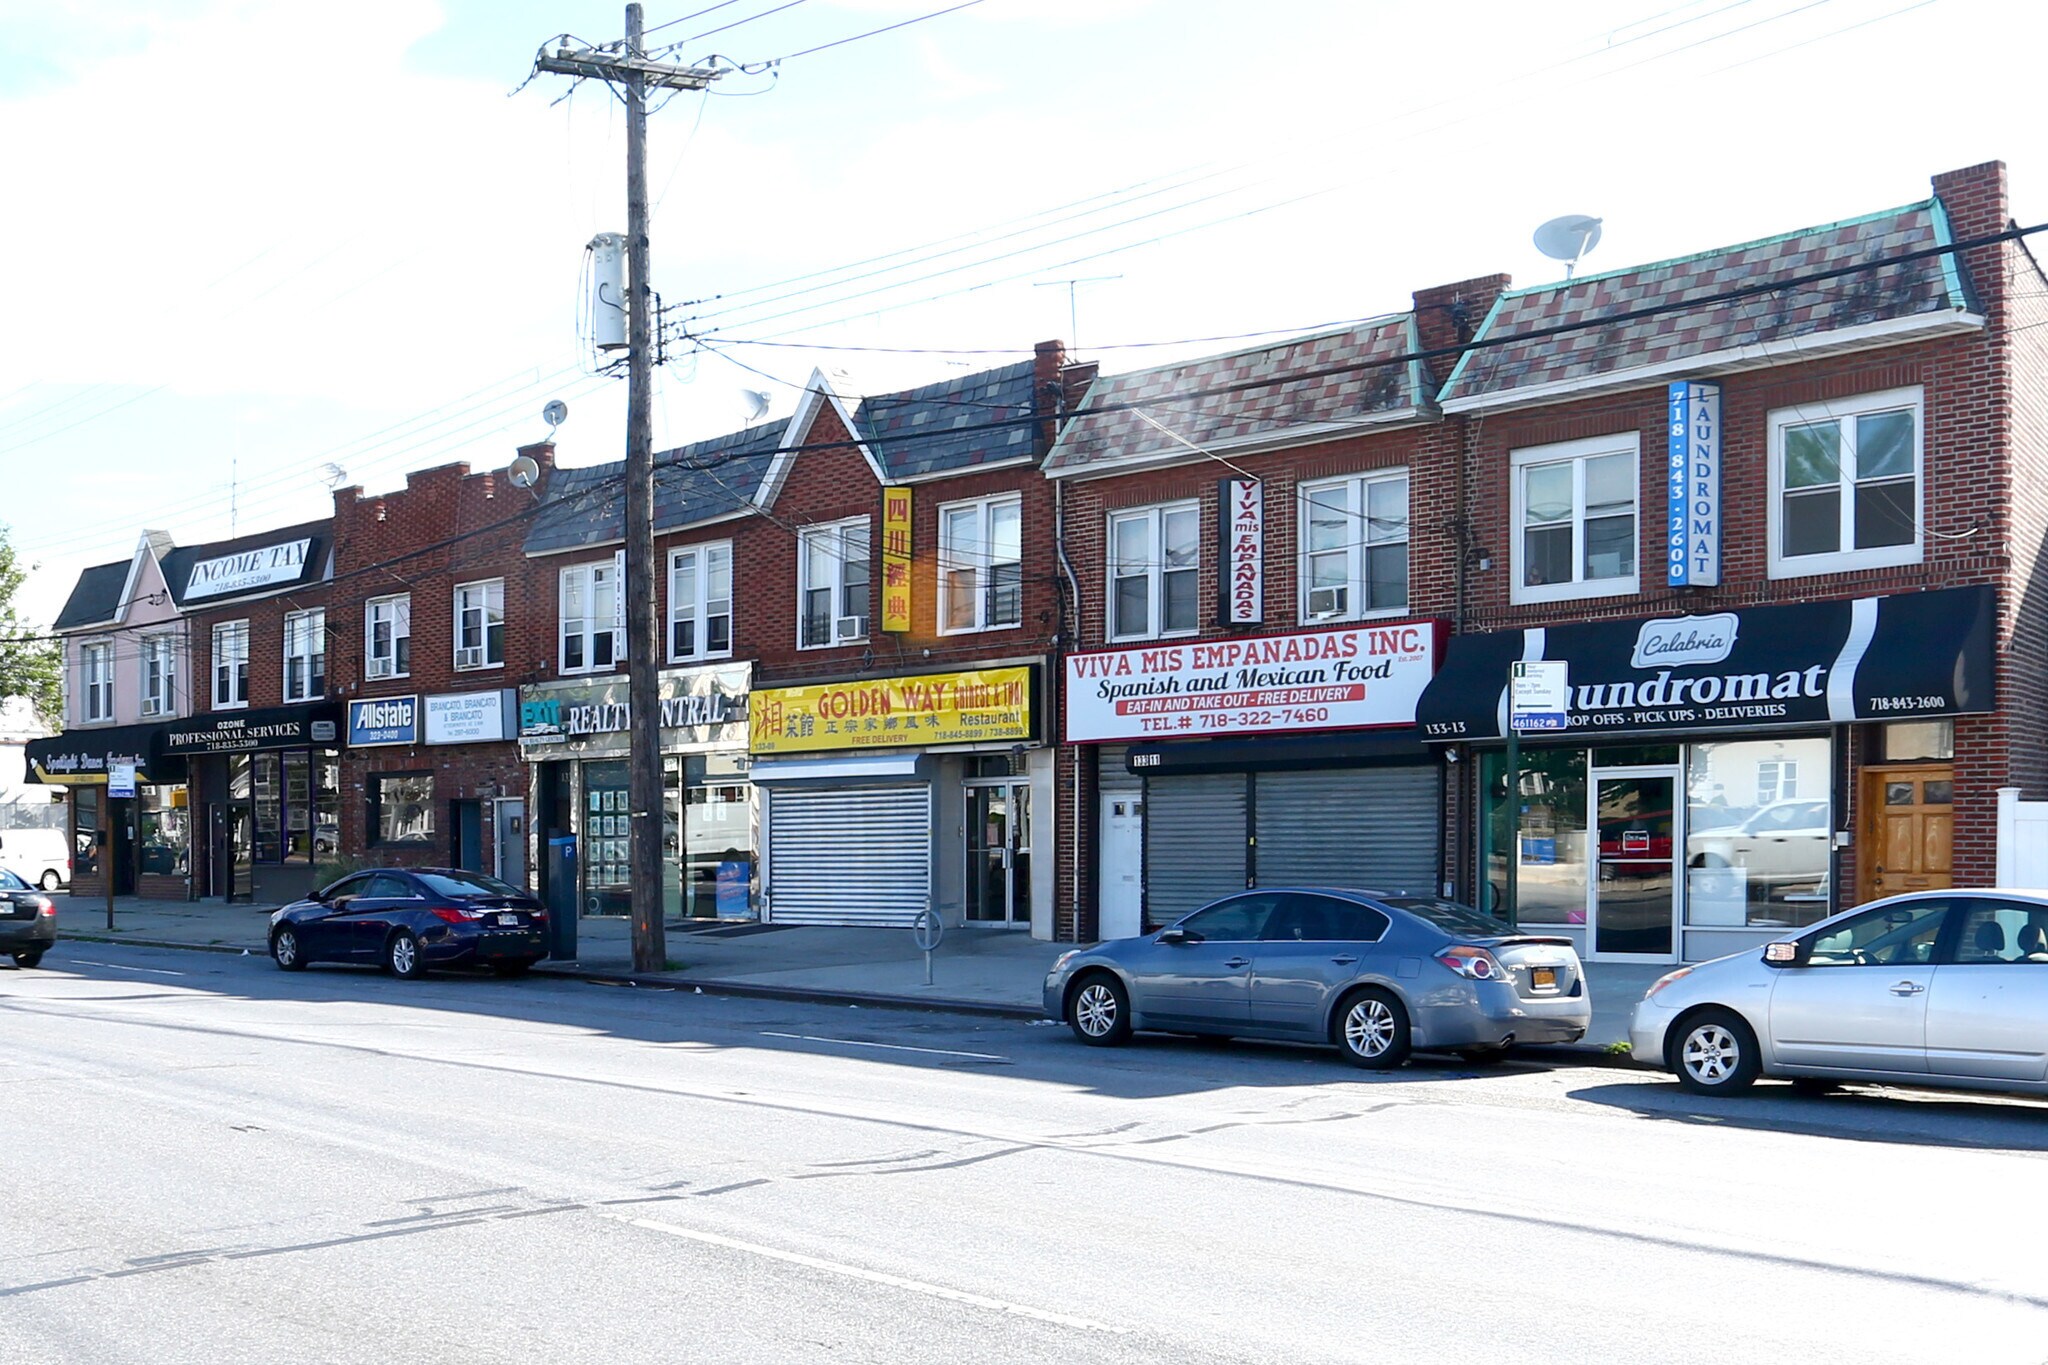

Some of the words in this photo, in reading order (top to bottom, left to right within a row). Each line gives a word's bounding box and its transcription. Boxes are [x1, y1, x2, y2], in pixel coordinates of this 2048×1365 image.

[1693, 387, 1712, 573] LAUNDROMAT
[1237, 481, 1258, 520] VIVA
[1234, 521, 1260, 533] mis
[188, 551, 264, 588] INCOME
[270, 541, 309, 568] TAX
[1233, 534, 1258, 619] EMPANADAS
[1073, 652, 1132, 679] VIVA
[1141, 648, 1183, 674] MIS
[1192, 633, 1359, 670] EMPANADAS
[1369, 628, 1426, 655] INC.
[1642, 629, 1725, 656] Calabria
[1097, 678, 1180, 704] Spanish
[1186, 671, 1232, 692] and
[1236, 666, 1327, 690] Mexican
[1333, 658, 1395, 683] Food
[1516, 663, 1522, 678] 1
[953, 684, 991, 711] CHINESE
[993, 683, 1000, 707] &
[1003, 681, 1024, 706] THAI
[1567, 664, 1828, 711] undromat
[430, 700, 462, 712] BRANCATO,
[464, 697, 497, 709] BRANCATO
[521, 699, 560, 728] EXIT
[659, 694, 725, 728] NTRAL
[817, 687, 892, 720] GOLDEN
[900, 682, 946, 713] WAY
[1126, 701, 1163, 715] EAT-IN
[1164, 698, 1191, 712] AND
[1191, 696, 1222, 710] TAKE
[1223, 694, 1249, 708] OUT
[1257, 691, 1288, 706] FREE
[1290, 687, 1352, 703] DELIVERY
[1870, 695, 1945, 711] 718-843-2600
[217, 719, 246, 730] OZONE
[356, 701, 412, 730] Allstate
[450, 710, 483, 721] BRANCATO
[960, 710, 1020, 727] Restaurant
[1140, 715, 1193, 731] TEL.#
[1199, 706, 1329, 728] 718-322-7460
[1425, 721, 1467, 735] 133-13
[1513, 718, 1546, 728] 461162
[1566, 715, 1591, 727] ROP
[1592, 712, 1625, 725] OFFS
[1633, 710, 1667, 724] PICK
[1669, 708, 1695, 722] UPS
[1705, 704, 1787, 720] DELIVERIES
[169, 729, 245, 747] PROFESSIONAL
[247, 722, 300, 739] SERVICES
[852, 736, 870, 745] FREE
[872, 734, 909, 744] DELIVERY
[565, 846, 572, 857] P
